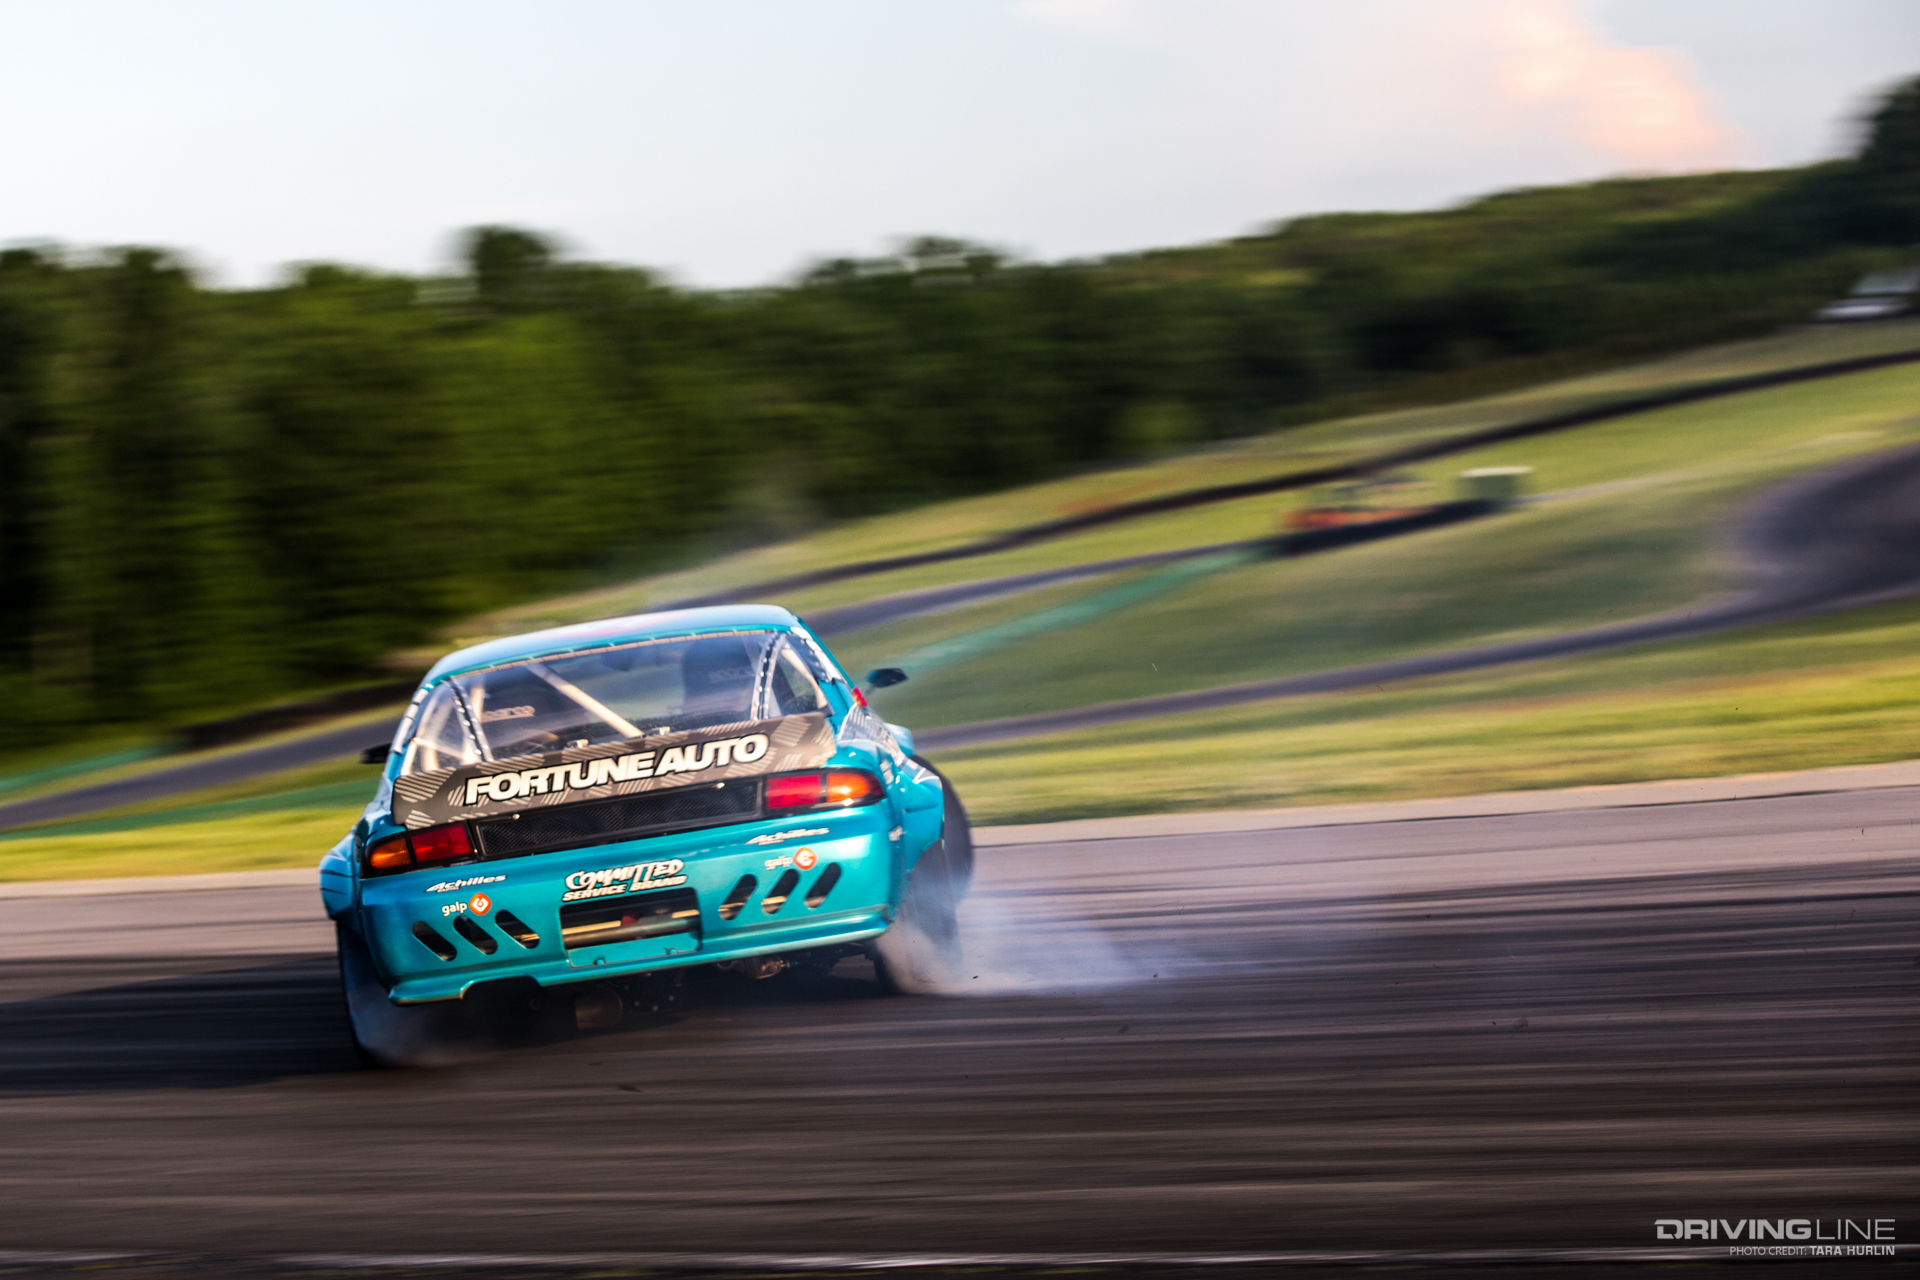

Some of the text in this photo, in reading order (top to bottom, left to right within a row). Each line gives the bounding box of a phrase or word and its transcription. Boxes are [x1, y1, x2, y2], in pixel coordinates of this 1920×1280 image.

[424, 874, 507, 893] Achilles
[561, 875, 688, 902] SERVICE BRAND
[441, 900, 468, 917] galp
